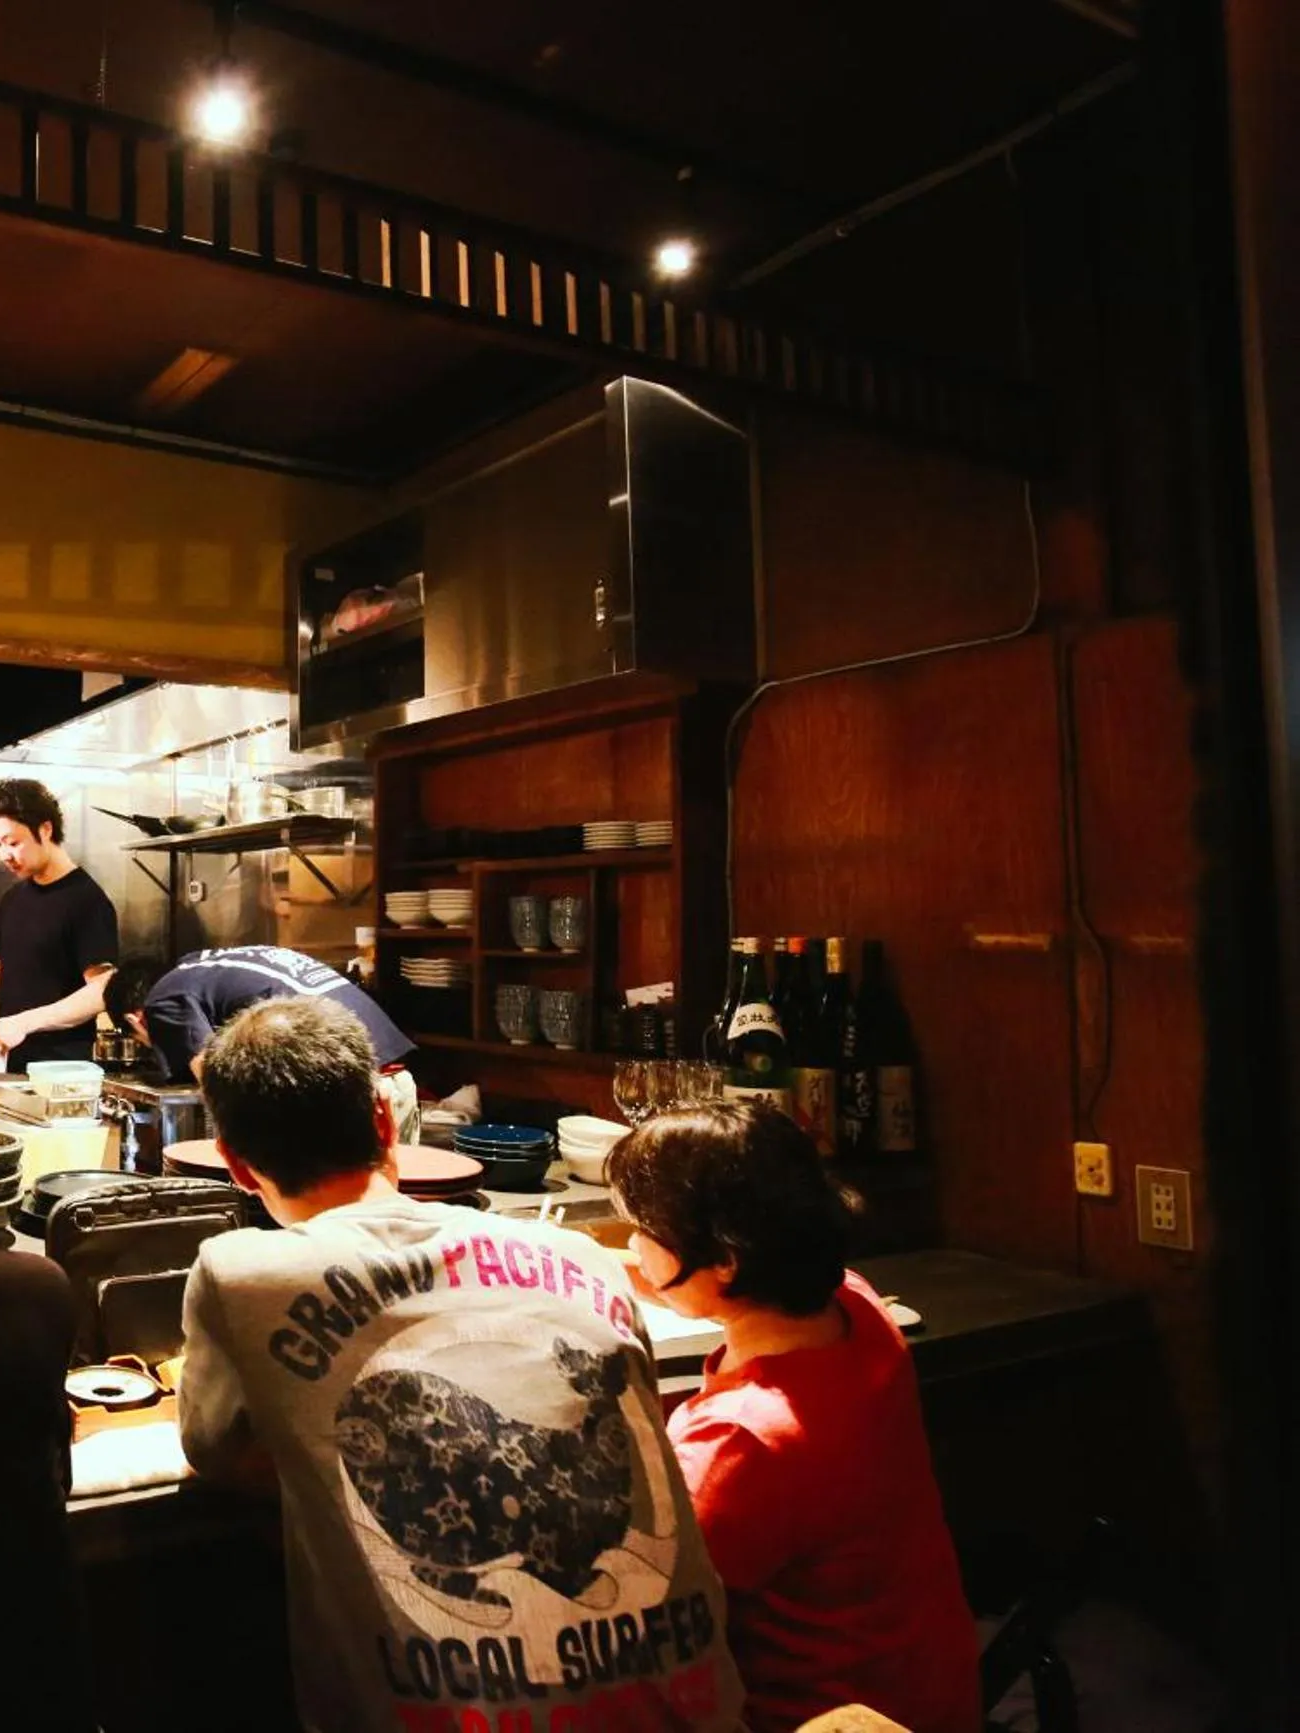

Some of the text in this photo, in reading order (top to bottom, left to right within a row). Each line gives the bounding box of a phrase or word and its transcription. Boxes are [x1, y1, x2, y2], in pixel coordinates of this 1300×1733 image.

[268, 1233, 635, 1381] GRAND PACIFIC
[376, 1634, 547, 1699] LOCAL
